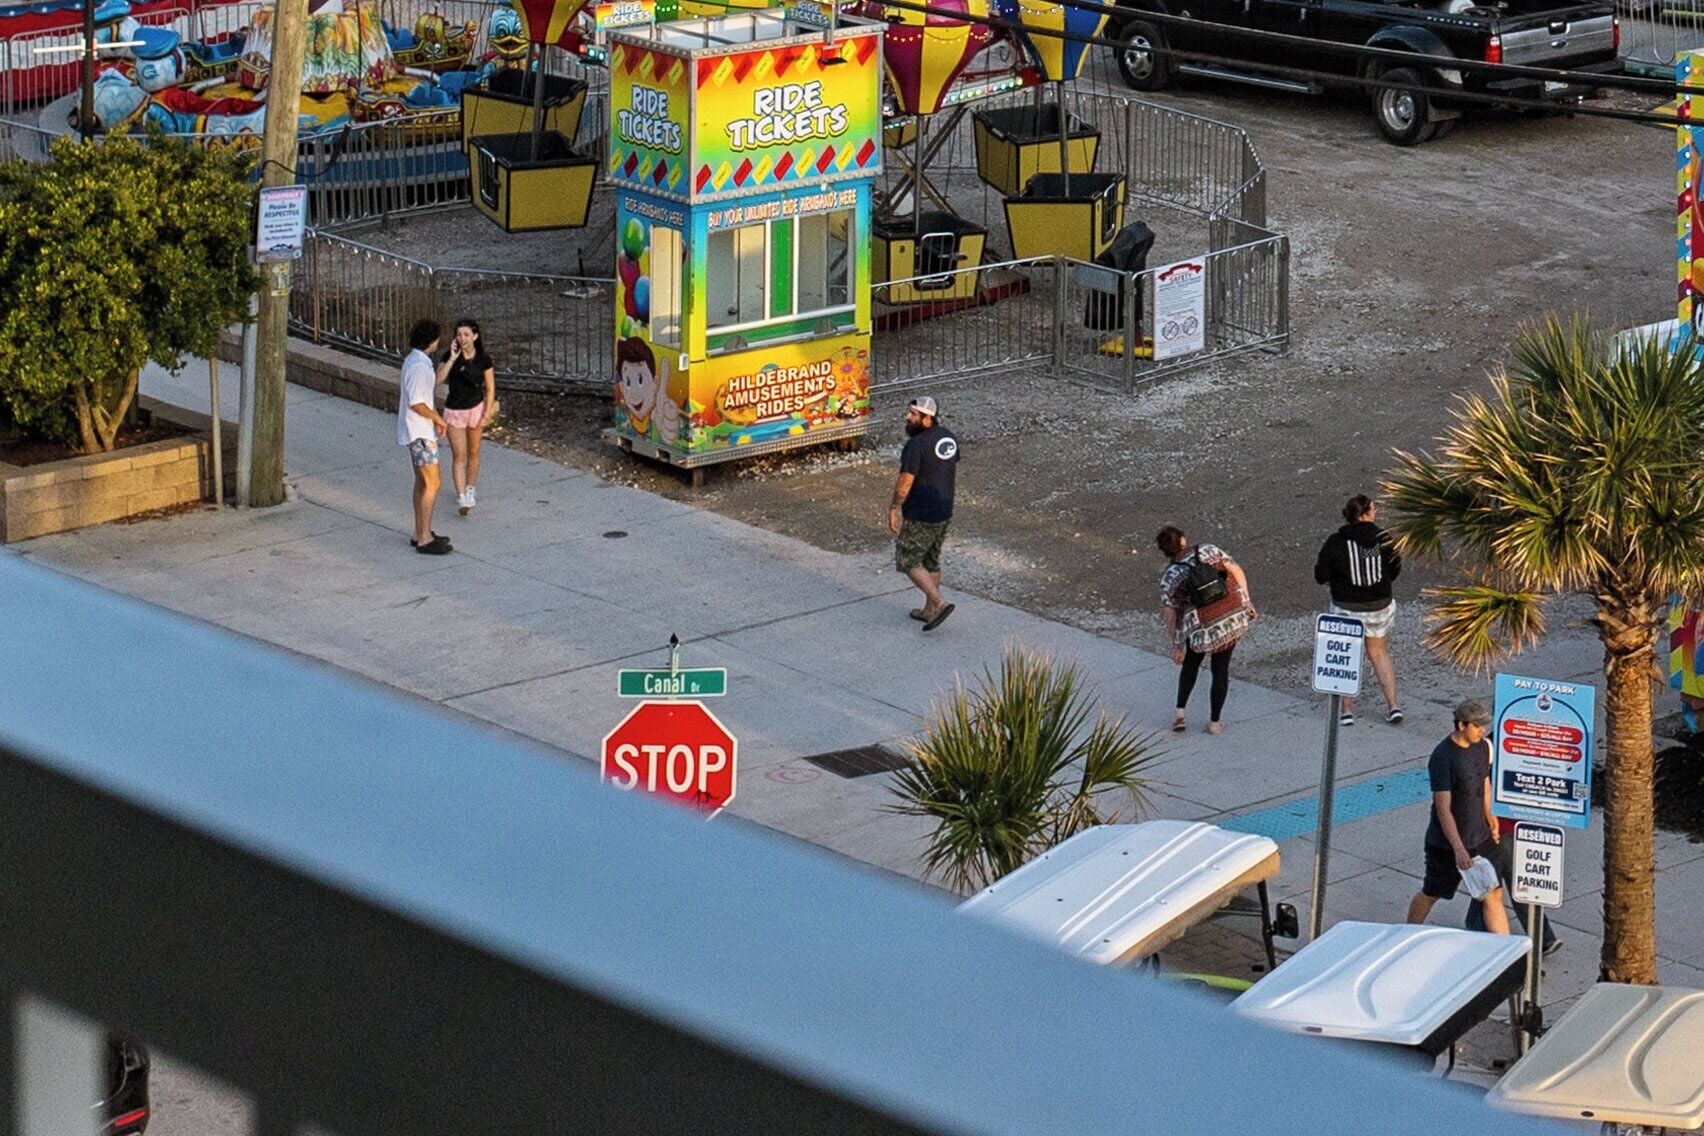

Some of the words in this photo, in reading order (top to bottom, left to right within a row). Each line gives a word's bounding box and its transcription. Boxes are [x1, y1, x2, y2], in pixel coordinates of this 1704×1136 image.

[613, 0, 642, 15] RIDE
[797, 0, 820, 13] RIDE
[602, 10, 651, 24] TICKETS
[788, 7, 830, 25] TICKETS
[631, 83, 668, 118] RIDE
[754, 80, 822, 115] RIDE
[618, 108, 683, 150] TICKETS
[727, 103, 848, 148] TICKETS
[624, 196, 638, 214] RIDE
[668, 209, 684, 226] HERE
[708, 212, 721, 229] BUY
[725, 207, 743, 226] YOUR
[744, 201, 781, 223] UNLIMITED
[783, 197, 798, 214] RIDE
[800, 192, 838, 212] ARMBANDS
[839, 189, 857, 207] HERE
[728, 361, 832, 392] HILDEBRAND
[724, 375, 836, 409] AMUSEMENTS
[756, 395, 805, 418] RIDES
[1320, 620, 1362, 636] RESERVED
[1326, 640, 1352, 652] GOLF
[1325, 653, 1351, 667] CART
[1317, 666, 1358, 681] PARKING
[644, 673, 685, 694] Canal
[691, 682, 701, 693] Dr
[1513, 678, 1532, 690] PAY
[1534, 681, 1548, 692] TO
[1549, 683, 1575, 695] PARK
[611, 743, 727, 794] STOP
[1515, 773, 1536, 784] Text
[1537, 776, 1544, 785] 2
[1545, 777, 1567, 787] Park
[1517, 827, 1562, 846] RESERVED
[1525, 849, 1552, 862] GOLF
[1524, 862, 1552, 876] CART
[1517, 876, 1559, 891] PARKING
